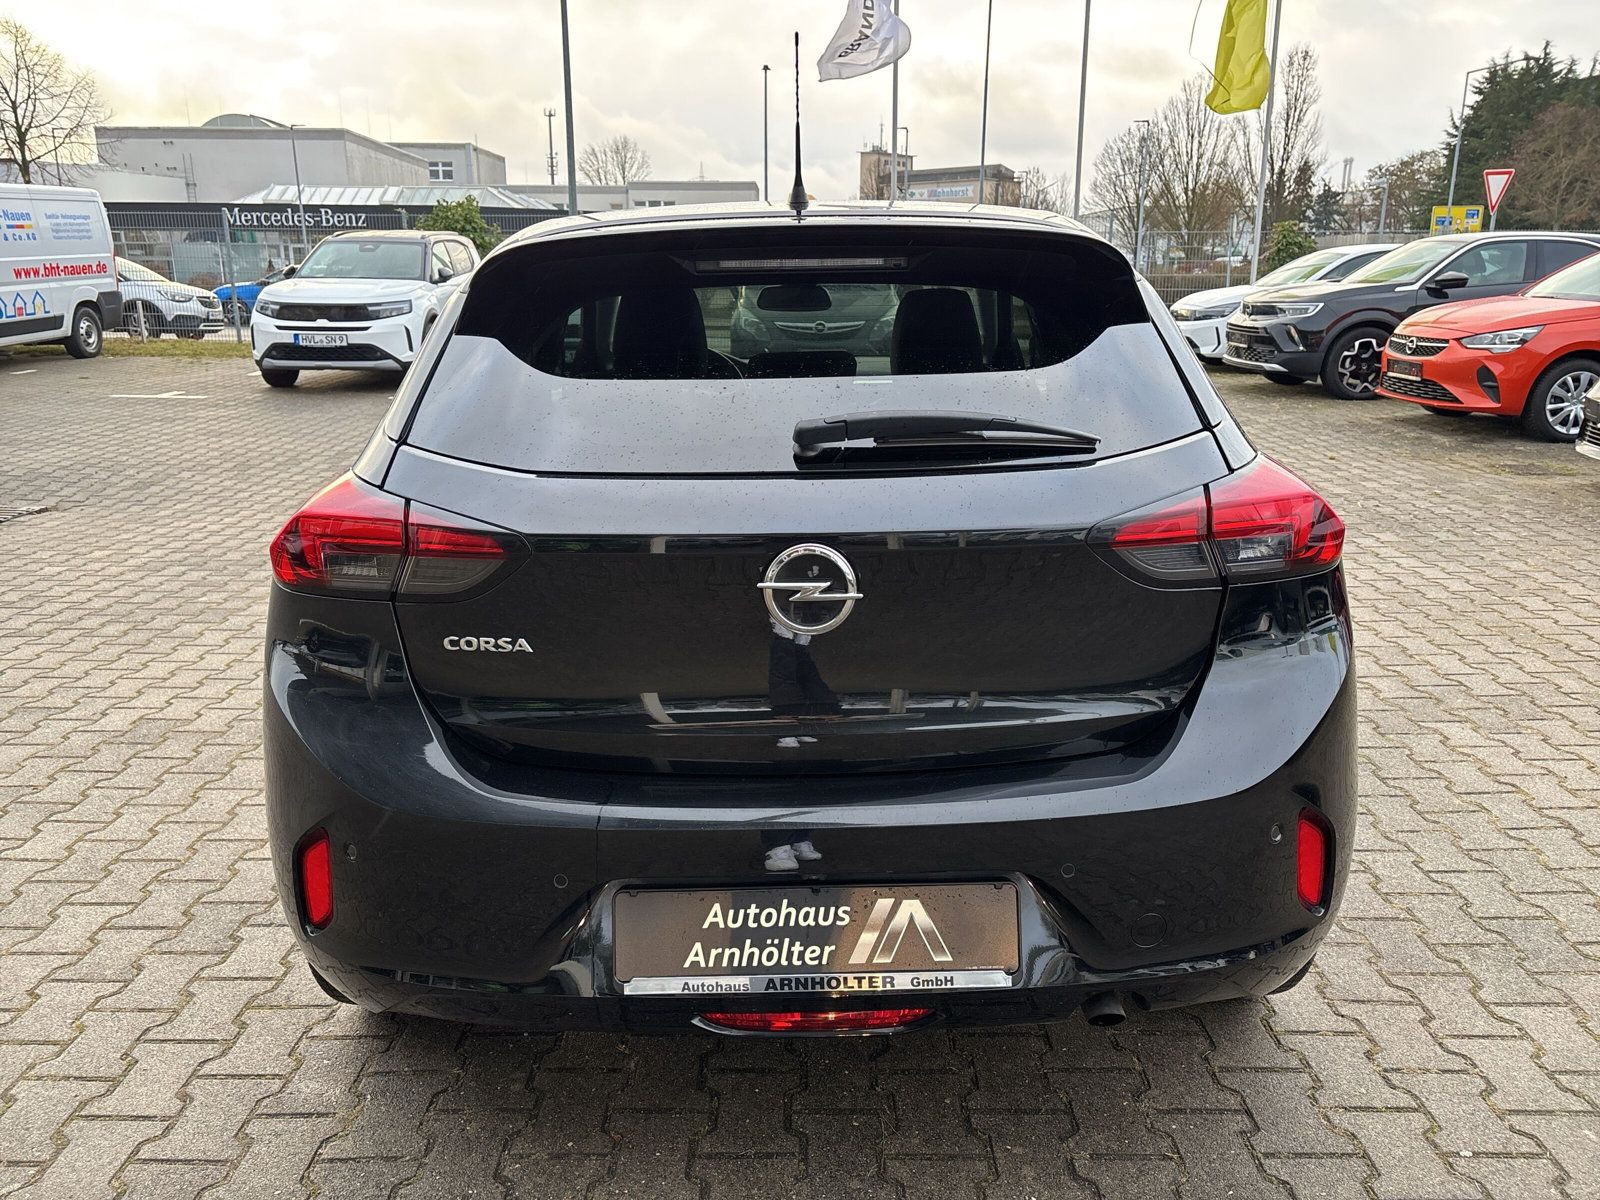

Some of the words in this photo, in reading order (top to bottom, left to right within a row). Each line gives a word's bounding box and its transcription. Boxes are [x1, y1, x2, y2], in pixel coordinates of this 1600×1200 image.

[221, 207, 367, 227] Mercedes-Benz
[13, 261, 107, 279] www.bht-nauen.de
[325, 335, 337, 344] SN
[338, 335, 344, 344] 9
[443, 636, 534, 652] CORSA
[702, 899, 851, 929] Autohaus
[683, 937, 836, 968] Arnhölter
[681, 981, 750, 993] Autohaus
[910, 976, 954, 988] GmbH
